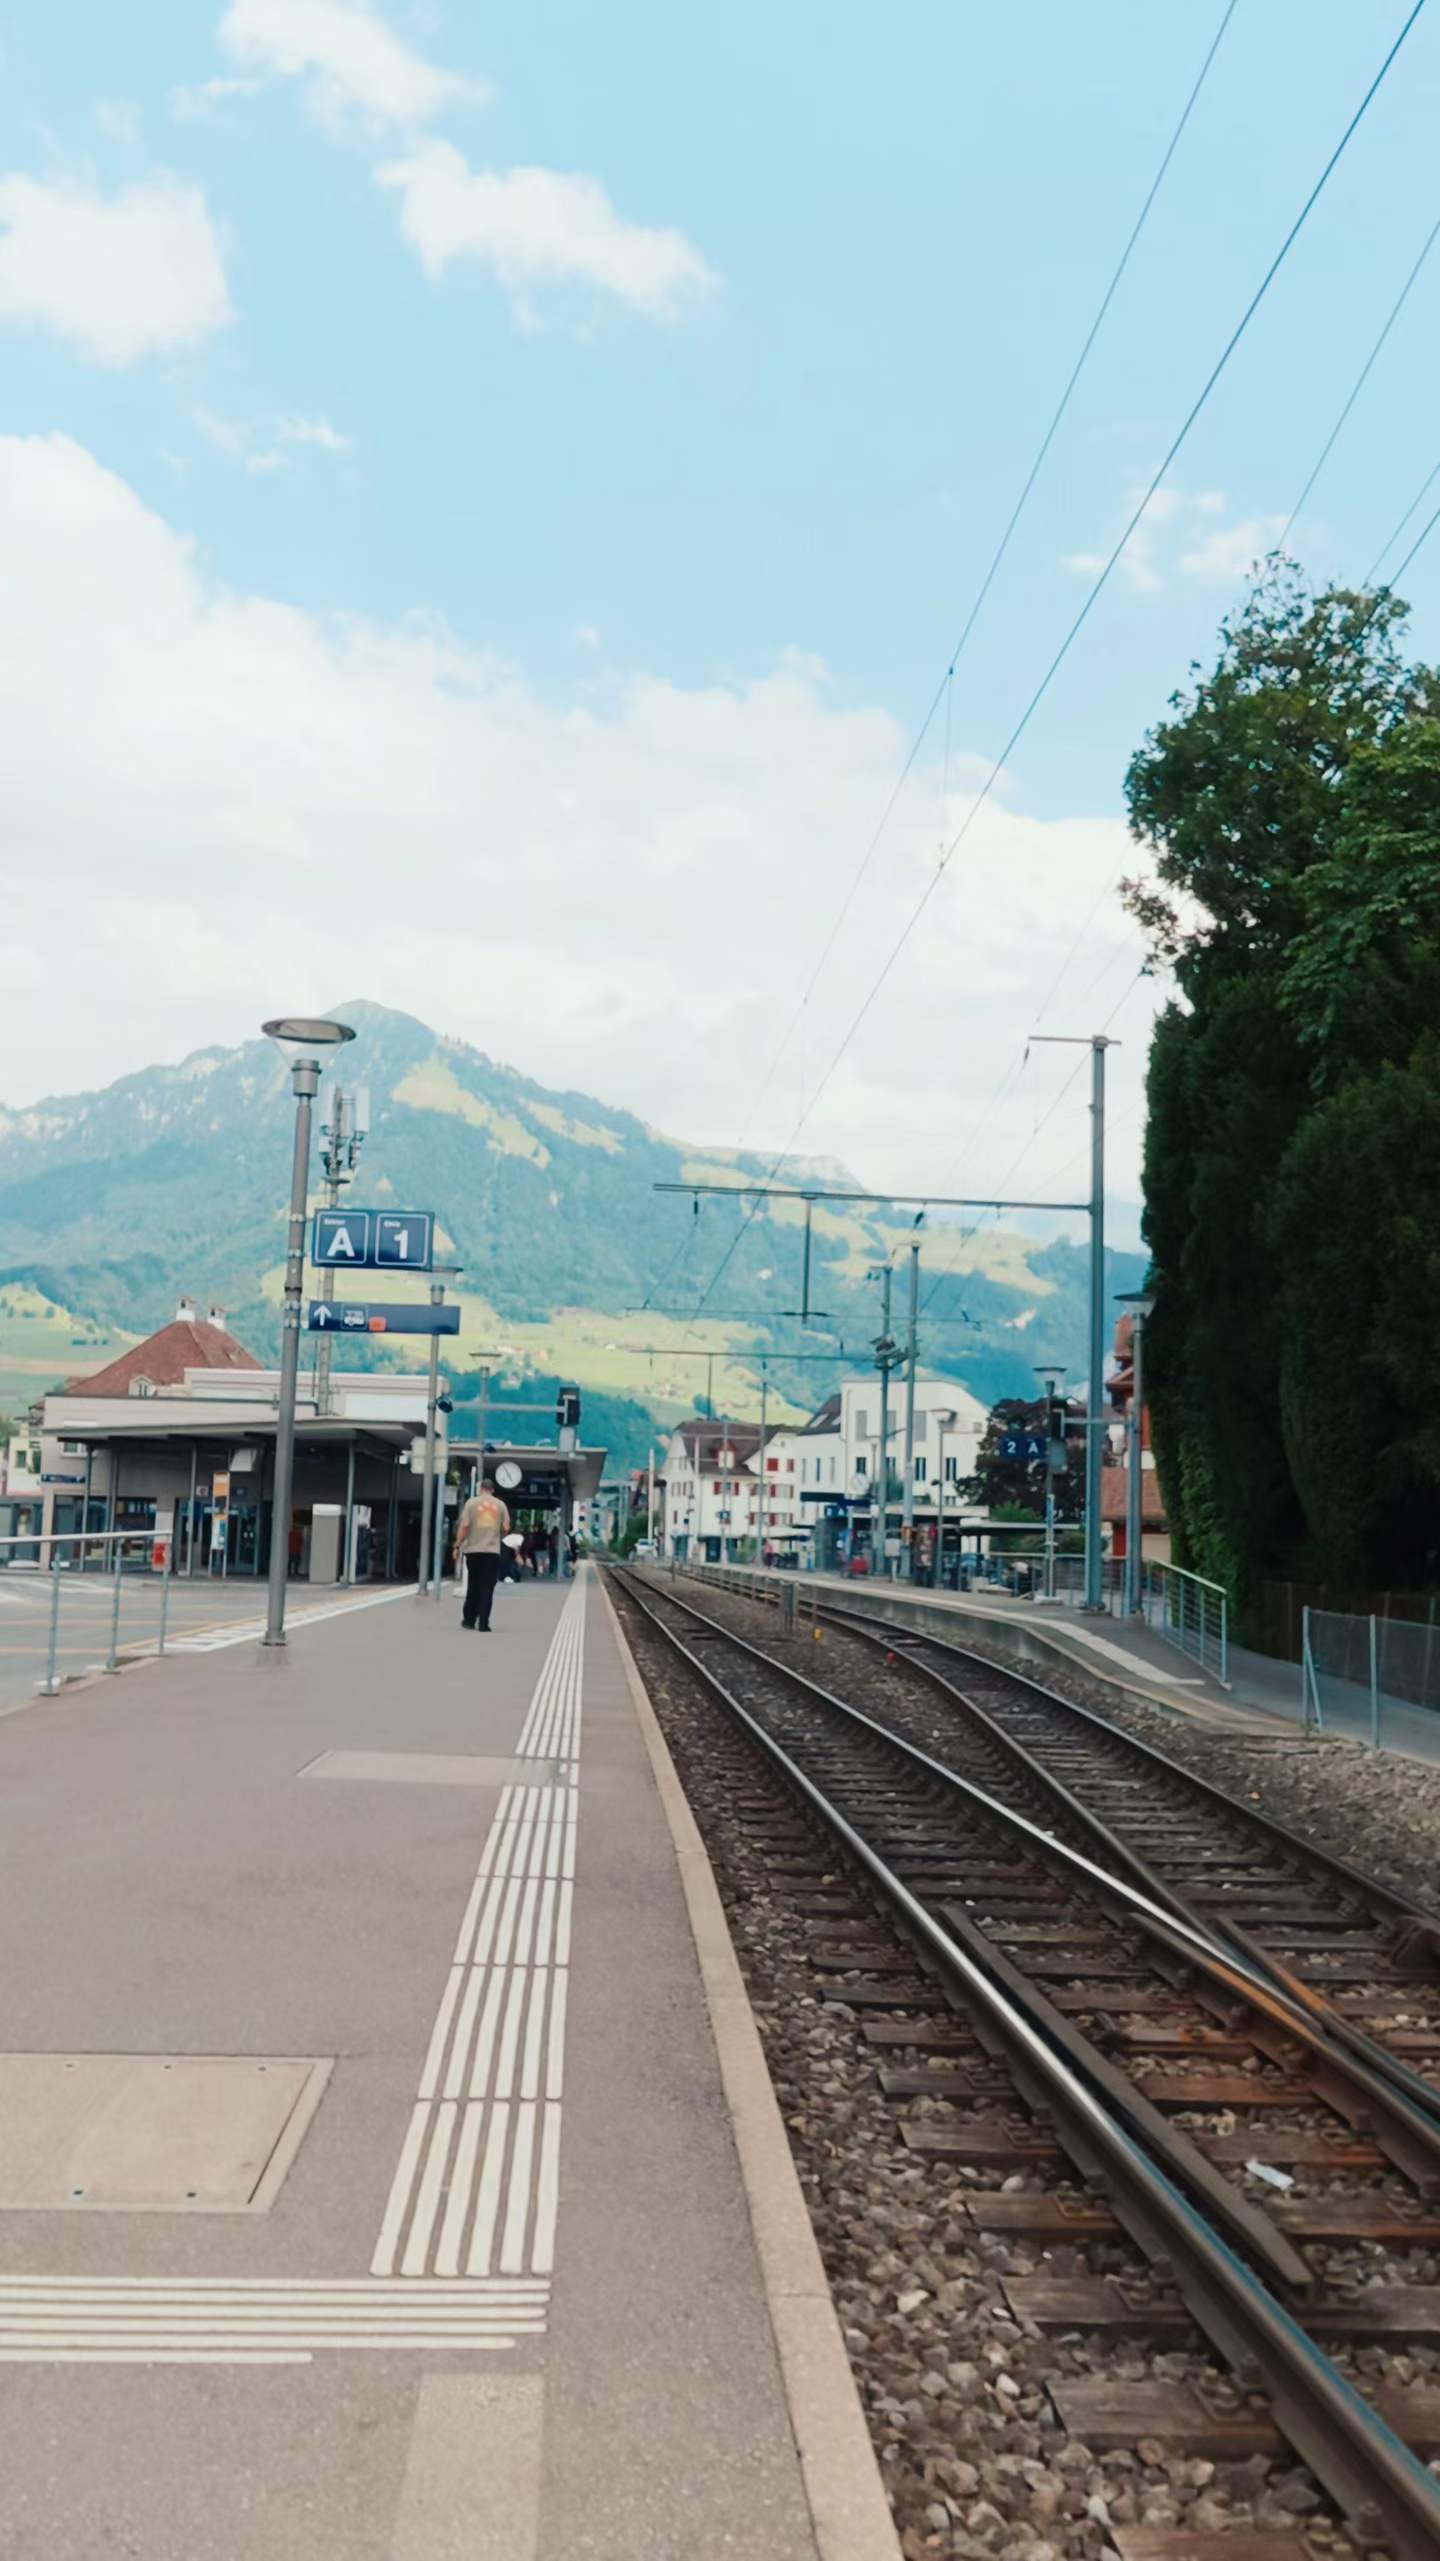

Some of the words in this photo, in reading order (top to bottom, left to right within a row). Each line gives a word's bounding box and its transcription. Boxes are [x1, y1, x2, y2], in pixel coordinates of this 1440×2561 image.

[327, 1227, 355, 1257] A
[394, 1229, 409, 1259] 1
[1007, 1441, 1016, 1454] 2
[1027, 1441, 1039, 1454] A
